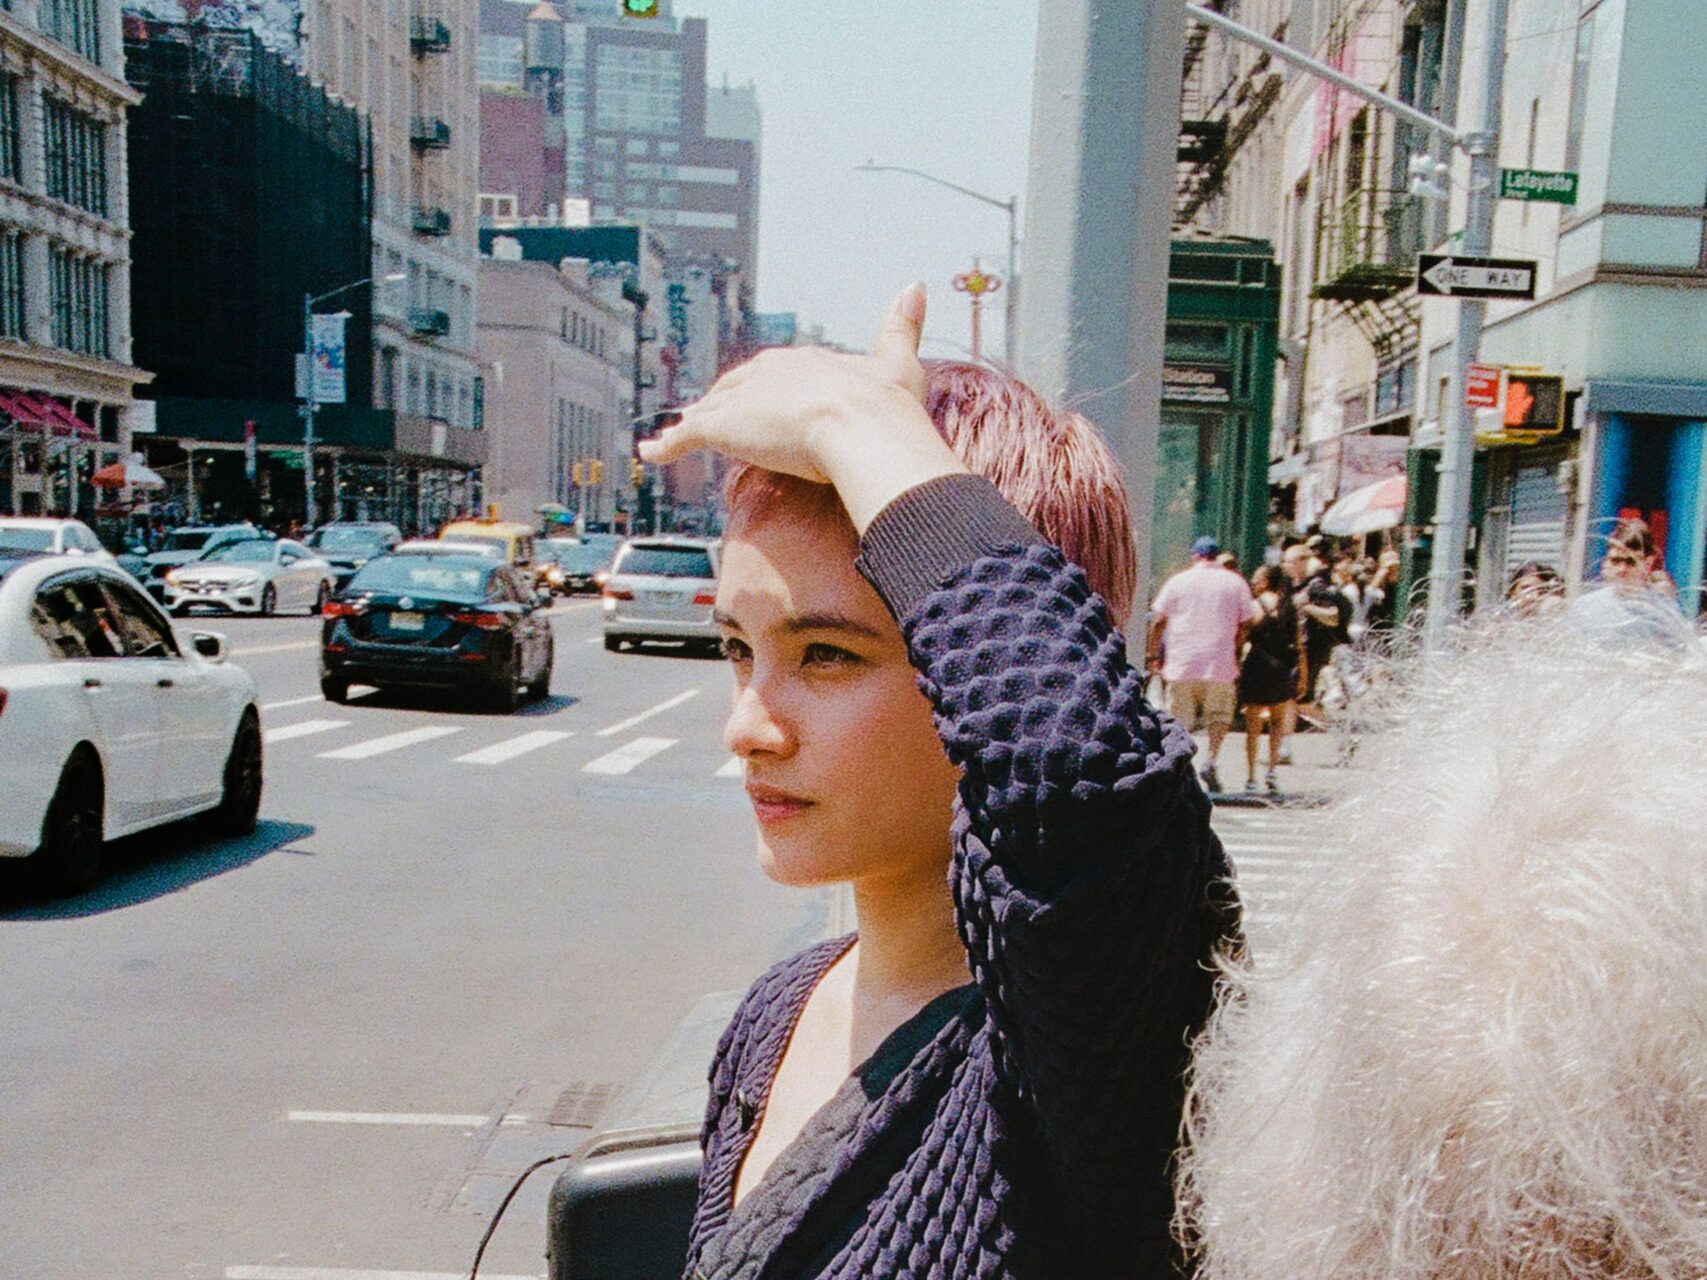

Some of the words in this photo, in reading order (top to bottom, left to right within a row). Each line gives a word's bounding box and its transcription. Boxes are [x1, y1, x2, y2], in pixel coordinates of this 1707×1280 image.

[1505, 170, 1574, 193] Lafayette
[1436, 267, 1469, 285] ONE
[1487, 271, 1522, 286] WAY
